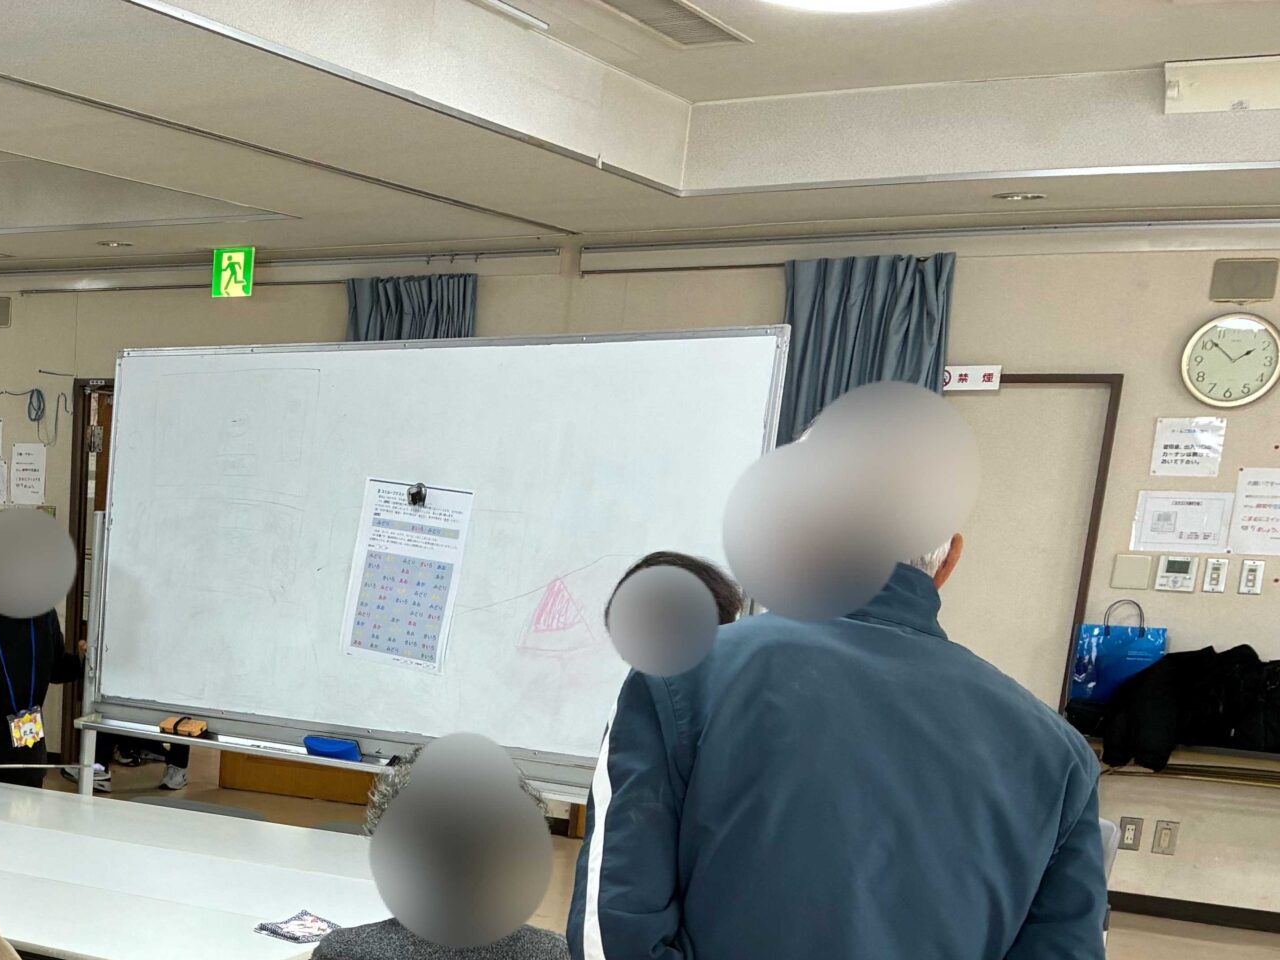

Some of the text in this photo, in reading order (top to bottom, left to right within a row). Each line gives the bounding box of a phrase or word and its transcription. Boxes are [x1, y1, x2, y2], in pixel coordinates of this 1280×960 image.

[1202, 340, 1214, 350] 10
[1262, 341, 1271, 351] 2
[1194, 355, 1204, 366] 9
[1264, 356, 1273, 367] 3
[1196, 371, 1205, 382] 8
[1256, 373, 1264, 382] 4
[1208, 383, 1217, 394] 7
[1223, 388, 1232, 398] 6
[1241, 384, 1250, 394] 5
